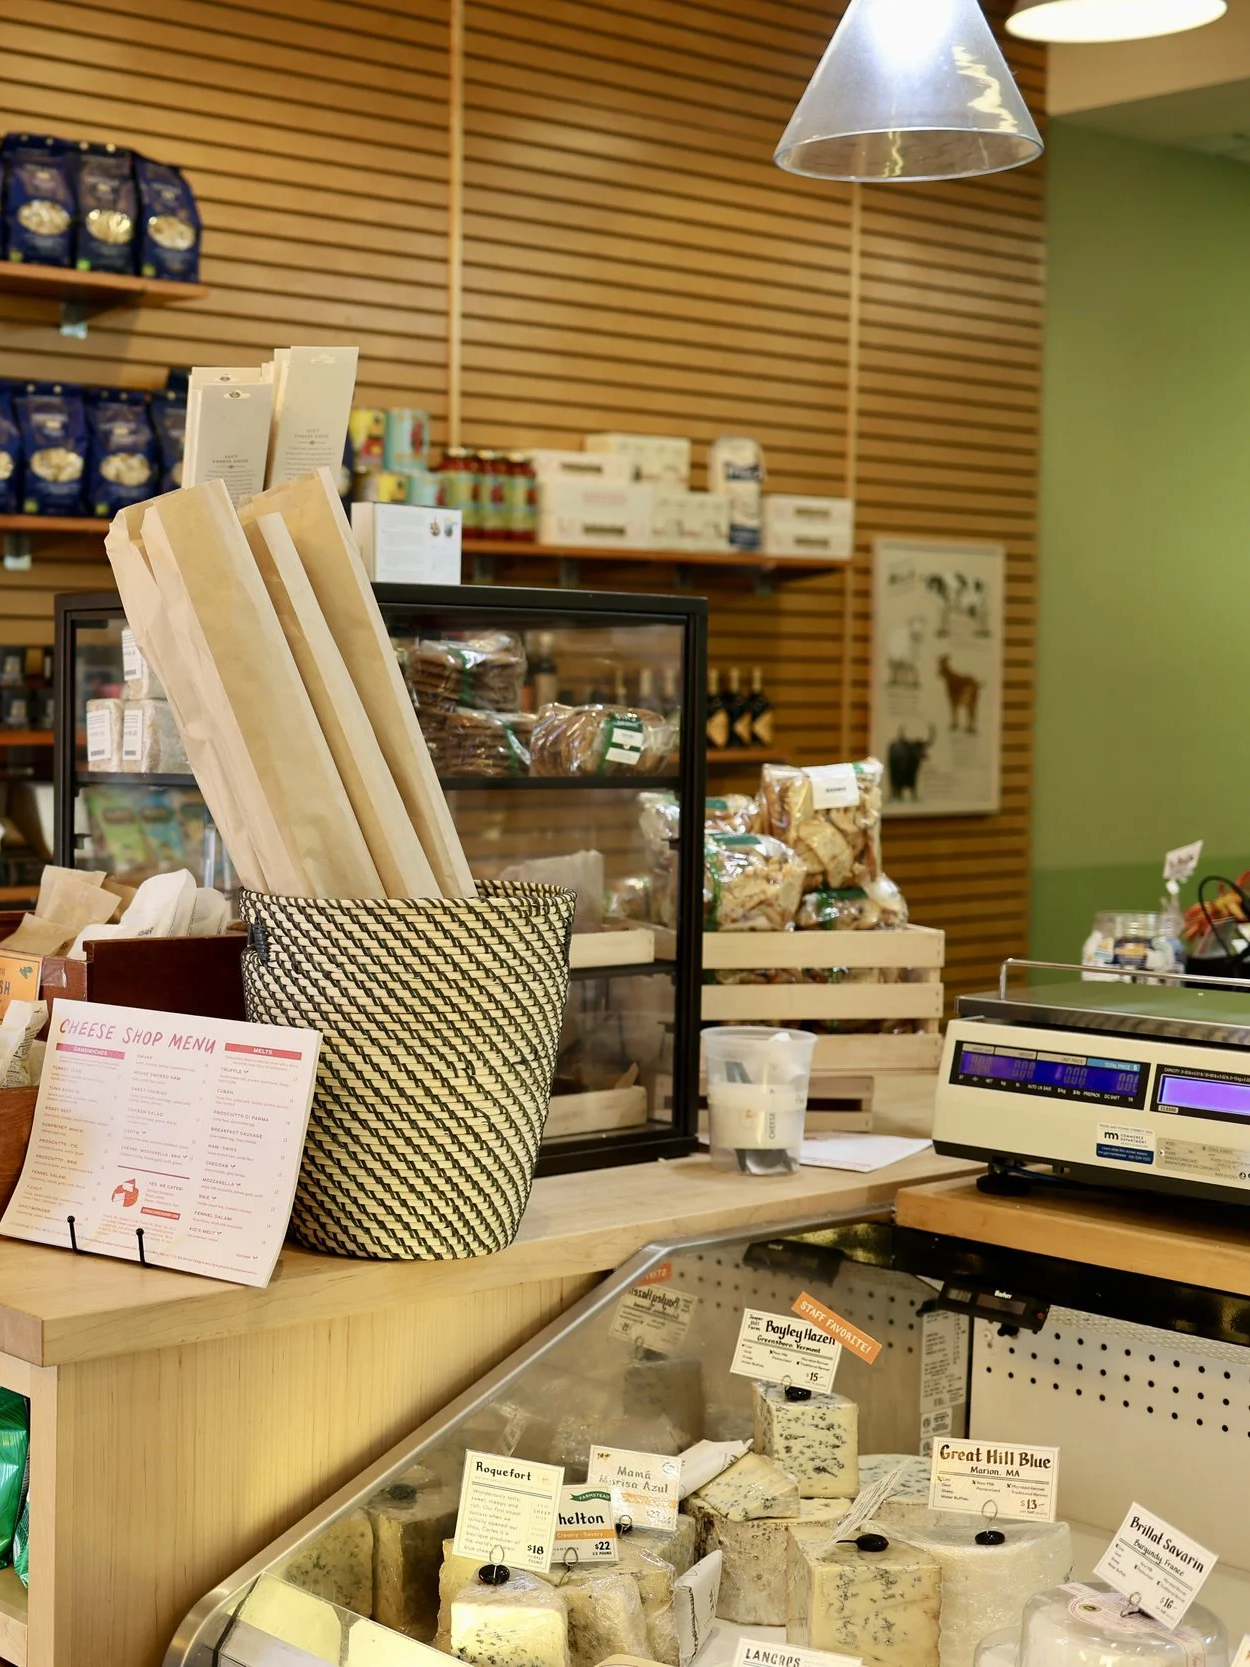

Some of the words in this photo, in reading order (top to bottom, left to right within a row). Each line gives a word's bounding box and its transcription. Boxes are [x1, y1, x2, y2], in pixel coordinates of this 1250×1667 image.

[60, 1018, 116, 1040] CHEESE
[122, 1028, 163, 1046] SHOP
[168, 1034, 216, 1054] MENU
[74, 1046, 108, 1056] SANDWICHES
[214, 1110, 244, 1118] PROSCIUTTO
[211, 1127, 239, 1135] BREAKFAST
[206, 1160, 228, 1168] CHEDDAR
[202, 1178, 235, 1186] MOZZARELLA
[800, 1300, 827, 1322] STAFF
[825, 1318, 872, 1354] FAVORITE!
[766, 1320, 803, 1343] Bayley
[804, 1329, 836, 1346] Hazen
[796, 1342, 821, 1354] Vermont
[940, 1444, 983, 1462] Great
[987, 1449, 1014, 1465] Hill
[1018, 1452, 1051, 1469] Blue
[475, 1461, 533, 1481] Roquefort
[617, 1466, 651, 1479] Mamá
[1006, 1469, 1020, 1477] MA
[643, 1484, 668, 1493] Azul
[579, 1492, 610, 1500] FARMSTEAD
[557, 1512, 605, 1525] helton
[527, 1544, 544, 1555] $18
[595, 1541, 611, 1551] $22
[1130, 1516, 1165, 1545] Brillat
[1163, 1538, 1204, 1574] Savarin
[1133, 1538, 1163, 1565] Burgundy,
[1164, 1559, 1185, 1577] France
